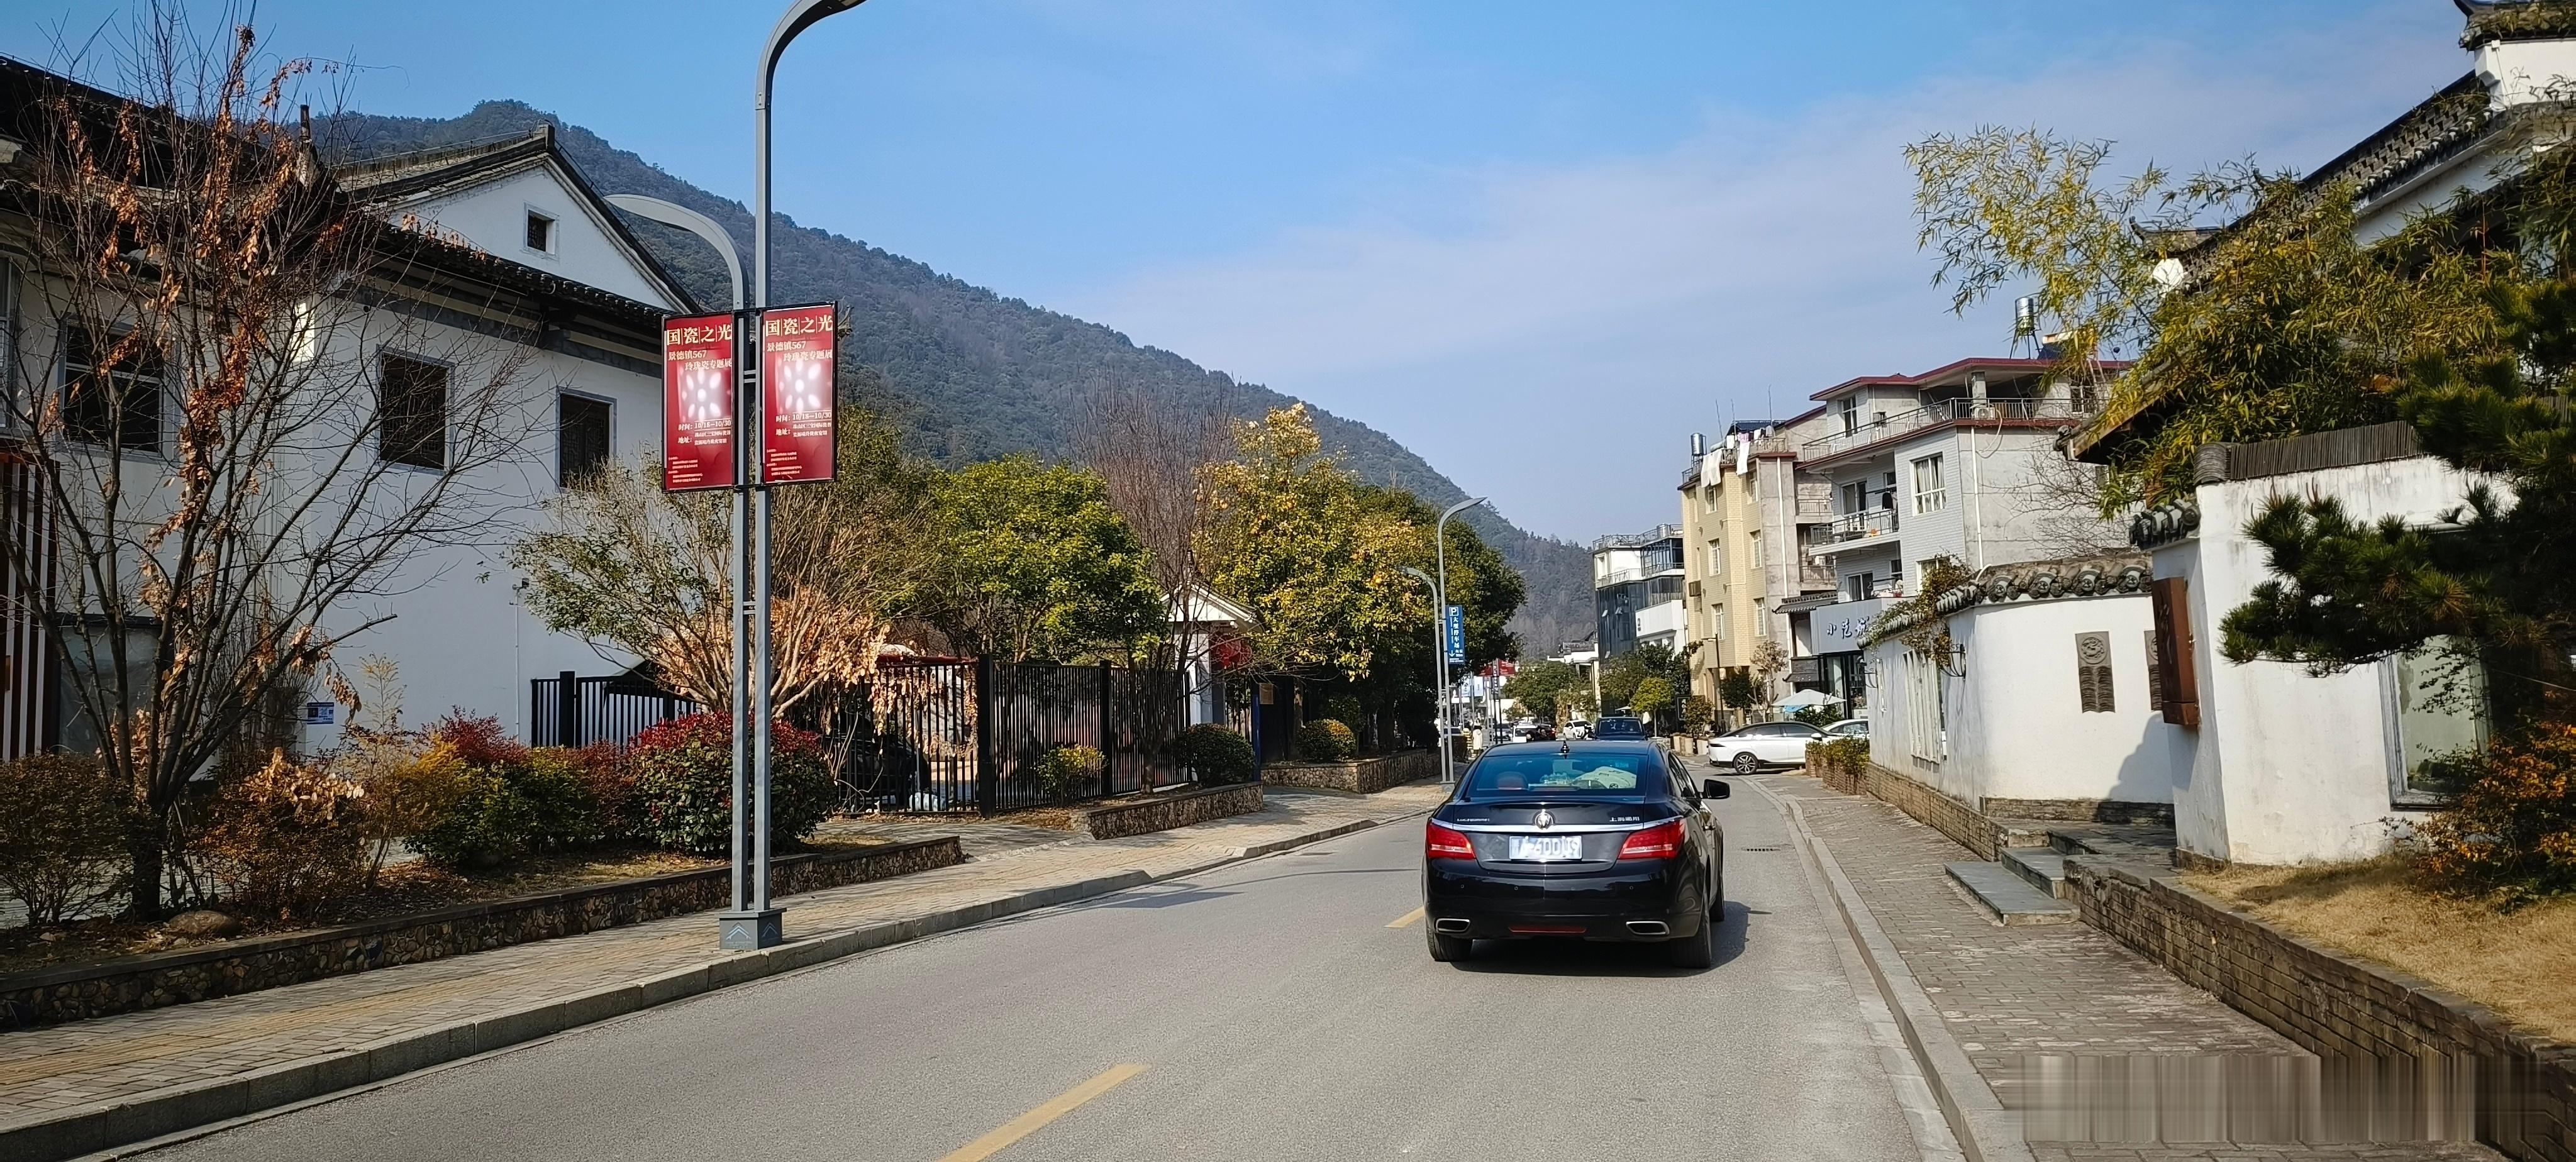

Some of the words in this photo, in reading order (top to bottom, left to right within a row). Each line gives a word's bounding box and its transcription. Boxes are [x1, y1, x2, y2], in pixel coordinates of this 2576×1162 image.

[766, 314, 833, 336] 国瓷之光
[667, 324, 732, 345] 国瓷之光
[767, 341, 806, 351] 景德镇567
[669, 350, 707, 361] 景德镇567
[783, 350, 833, 362] 玲珑瓷专题展
